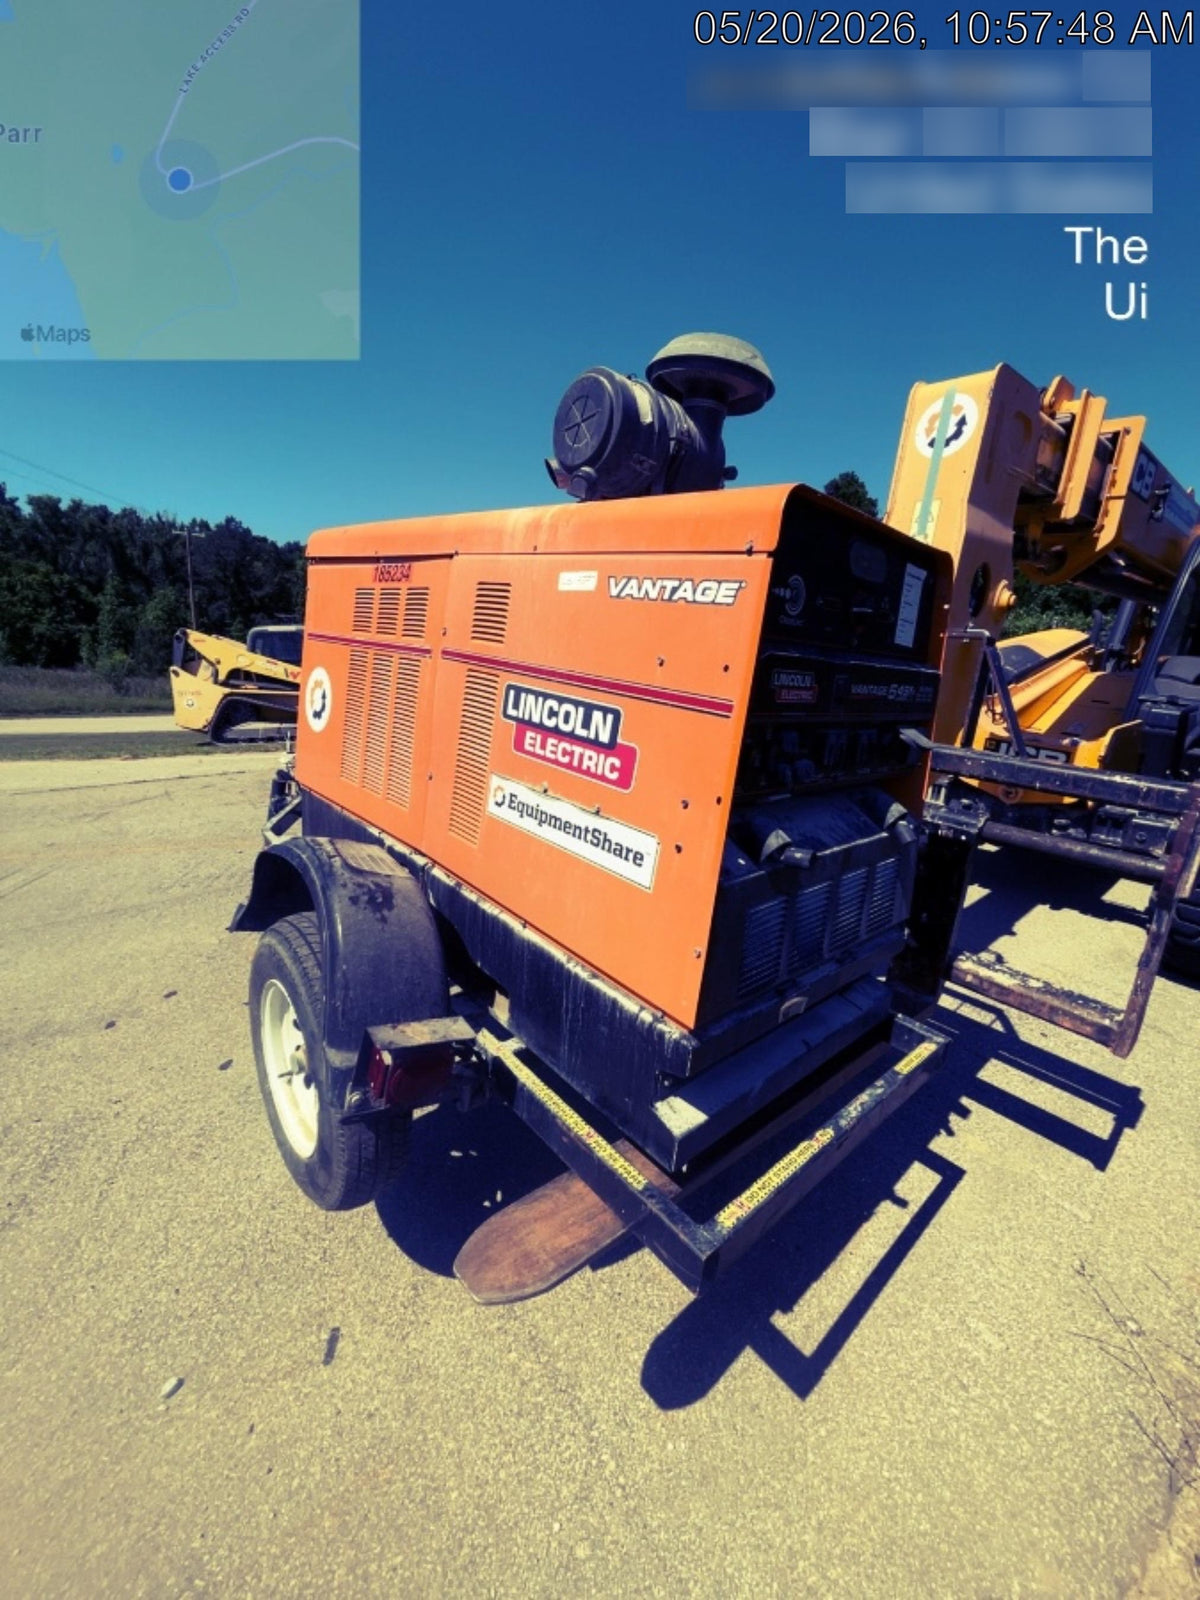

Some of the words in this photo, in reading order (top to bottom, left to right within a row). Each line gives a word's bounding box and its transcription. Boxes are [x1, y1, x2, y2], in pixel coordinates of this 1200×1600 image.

[373, 563, 411, 582] 185234
[608, 576, 743, 606] VANTAGE
[506, 689, 614, 744] LINCOLN
[523, 730, 621, 780] ELECTRIC
[507, 791, 645, 868] EquipmentShare
[744, 1190, 760, 1204] DO
[757, 1176, 774, 1192] NOT
[773, 1157, 798, 1178] STAND
